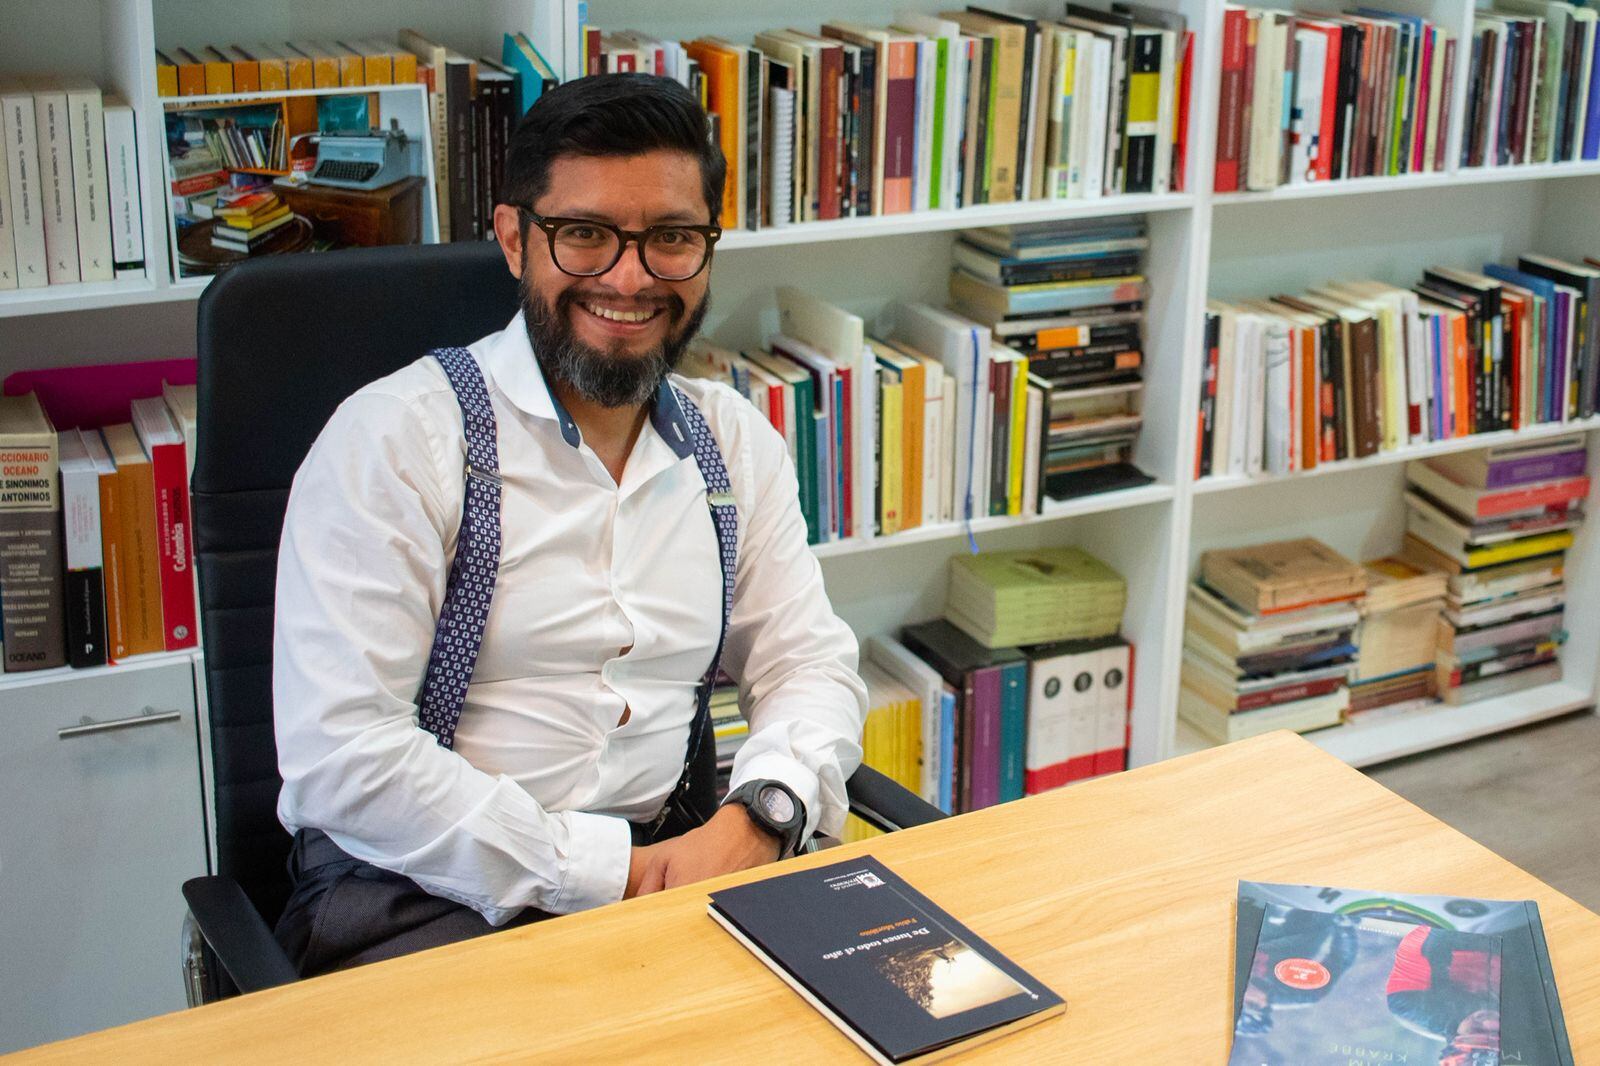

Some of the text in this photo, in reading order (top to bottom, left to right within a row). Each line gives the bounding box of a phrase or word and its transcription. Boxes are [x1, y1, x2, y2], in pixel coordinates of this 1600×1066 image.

[3, 465, 39, 476] OCEANO
[5, 479, 50, 489] SINONIMOS
[1, 492, 51, 502] ANTONIMOS
[172, 522, 186, 572] Colombia
[9, 652, 47, 662] OCEANO
[823, 927, 930, 959] De lunes todo el año
